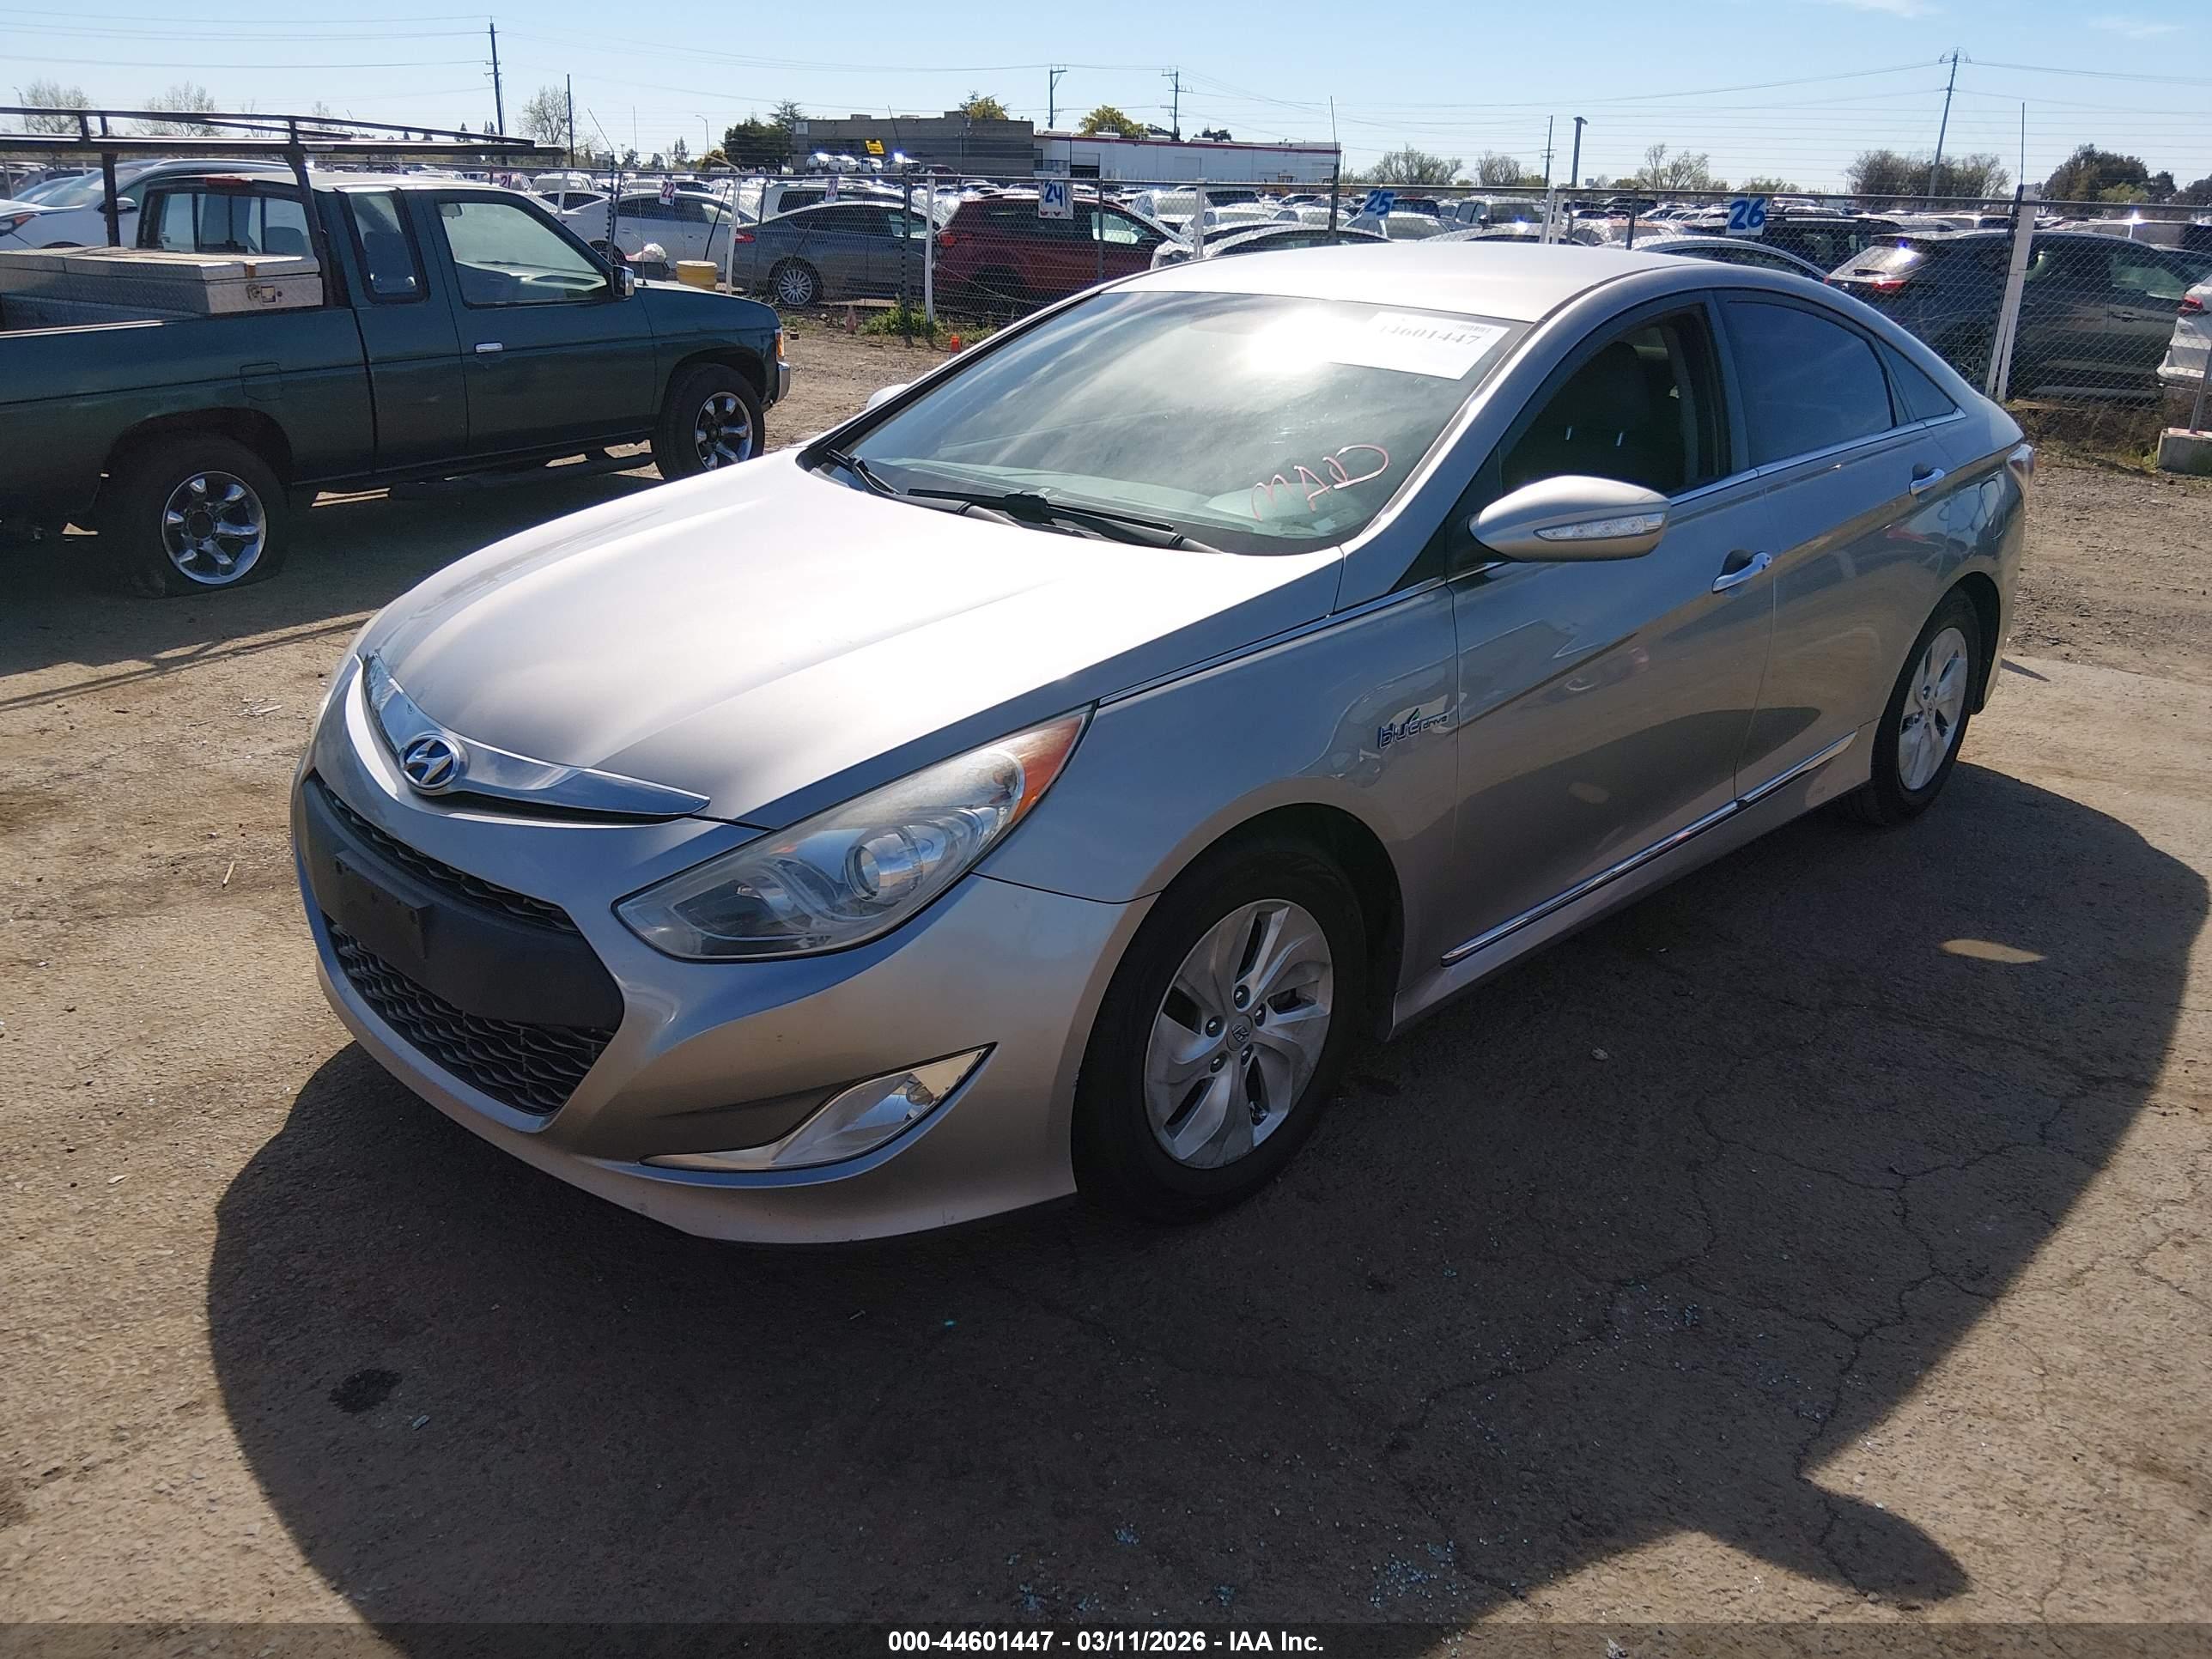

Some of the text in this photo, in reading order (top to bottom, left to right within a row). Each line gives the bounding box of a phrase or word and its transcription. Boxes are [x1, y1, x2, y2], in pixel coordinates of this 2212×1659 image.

[662, 180, 674, 198] 22
[1044, 182, 1063, 207] 24
[1364, 190, 1395, 216] 25
[1729, 197, 1765, 229] 26
[1251, 444, 1389, 521] MAD
